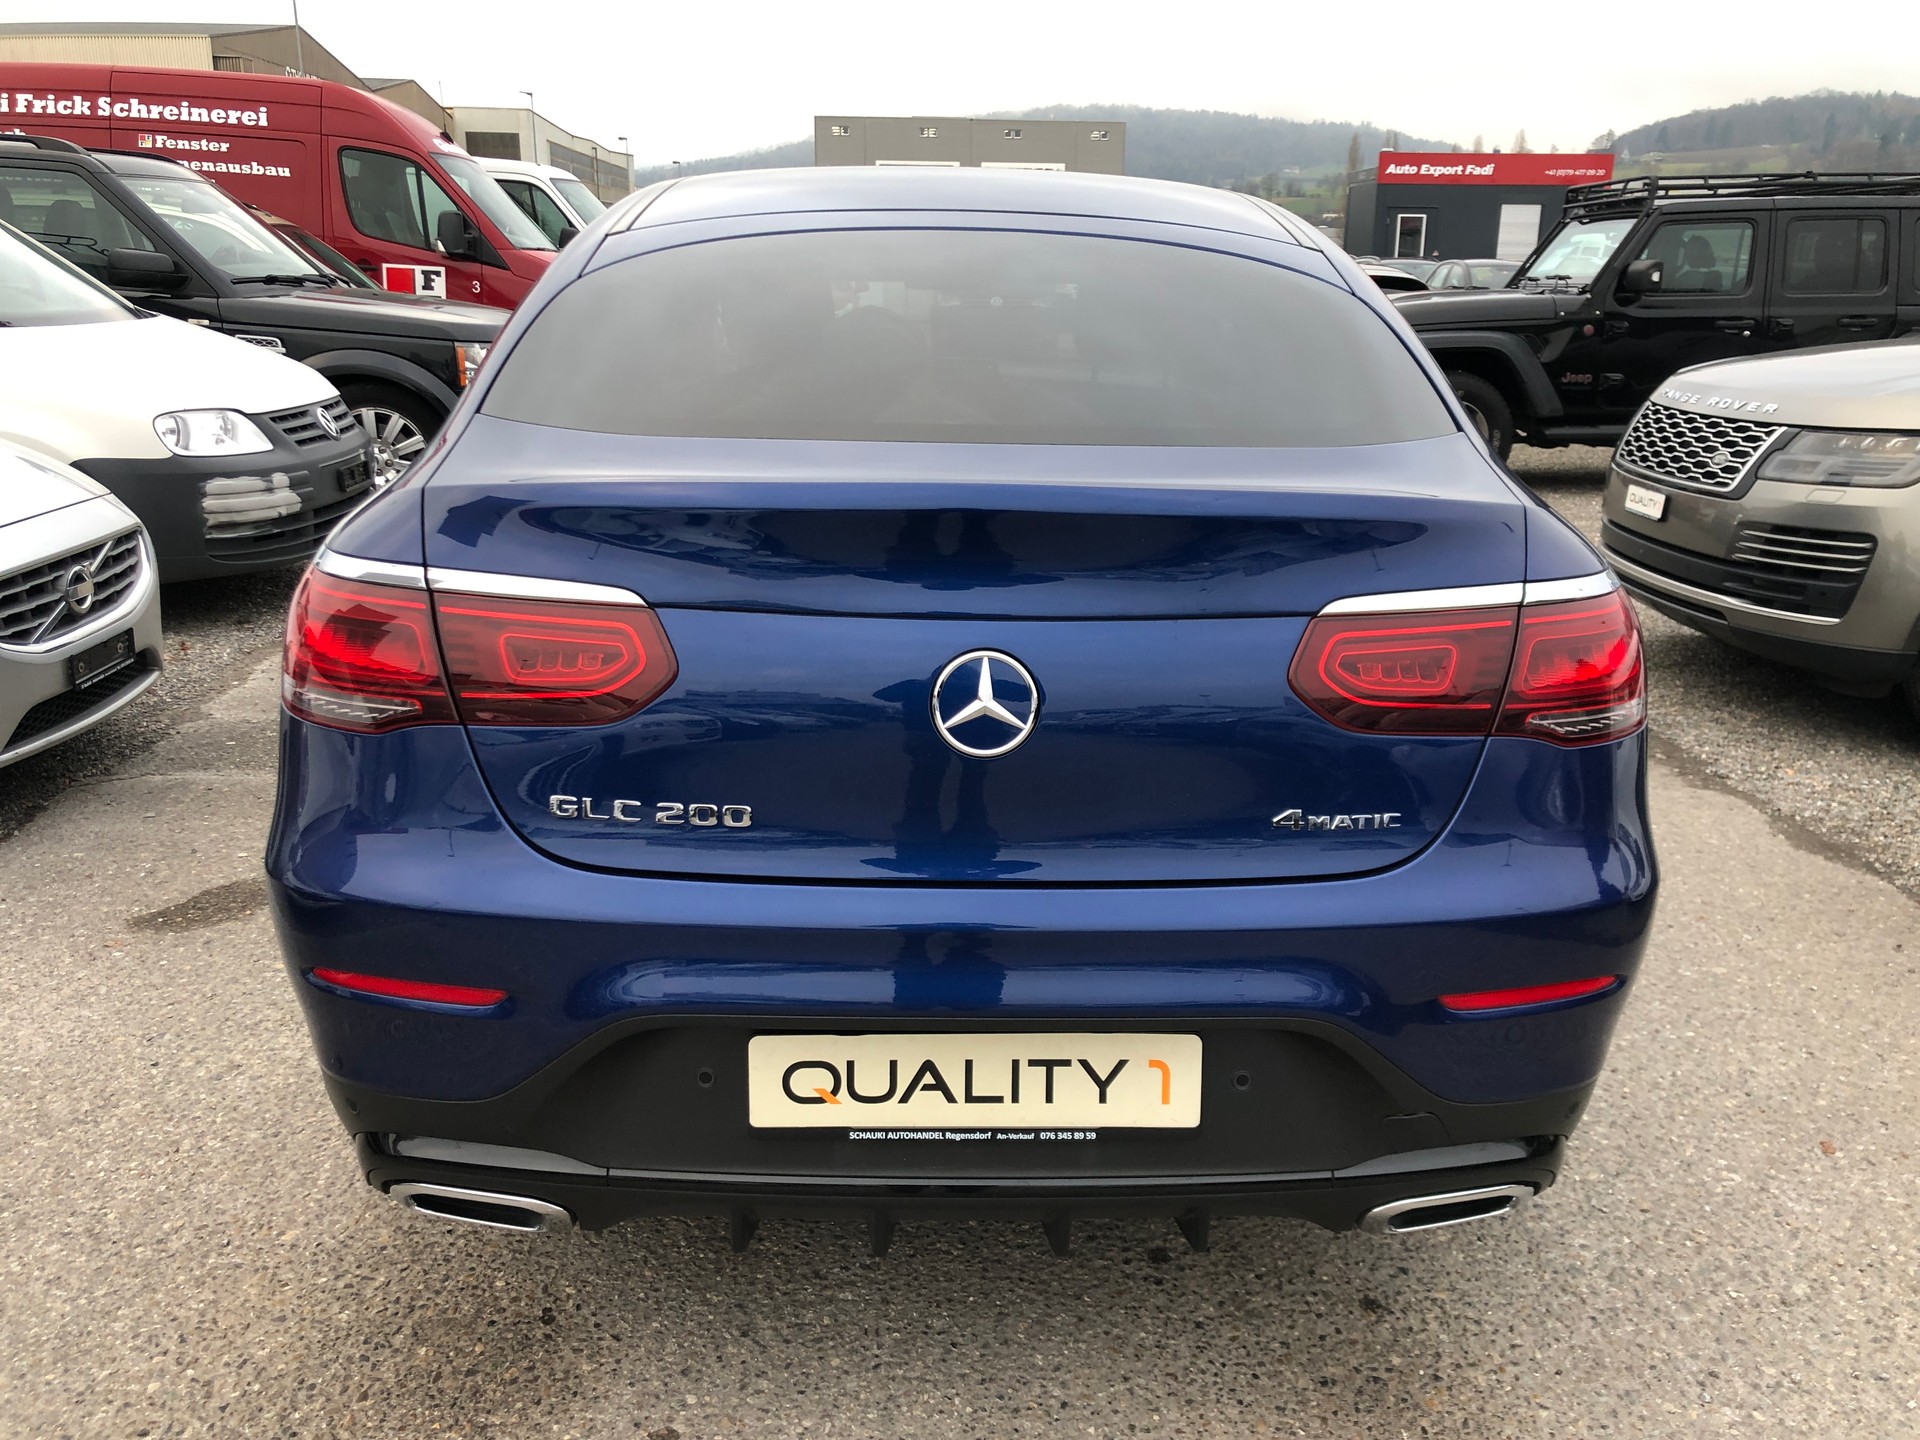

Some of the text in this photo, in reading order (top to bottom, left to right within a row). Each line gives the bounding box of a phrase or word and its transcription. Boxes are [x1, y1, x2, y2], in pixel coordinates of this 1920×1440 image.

[15, 93, 91, 115] Frick
[97, 96, 268, 126] Schreinerei
[155, 135, 230, 152] Fenster
[1385, 164, 1495, 177] Auto Export Fadi
[421, 270, 442, 291] F
[472, 281, 481, 293] 3
[1561, 372, 1593, 385] Jeep
[1707, 396, 1779, 414] ROVER
[549, 794, 753, 828] GLC 200
[1272, 809, 1402, 831] 4MATIC
[782, 1058, 1171, 1105] QUALITY 1
[849, 1131, 1097, 1141] SCHAUKI AUTOHANDEL Regensdorf An-Verkauf 076 345 89 59
